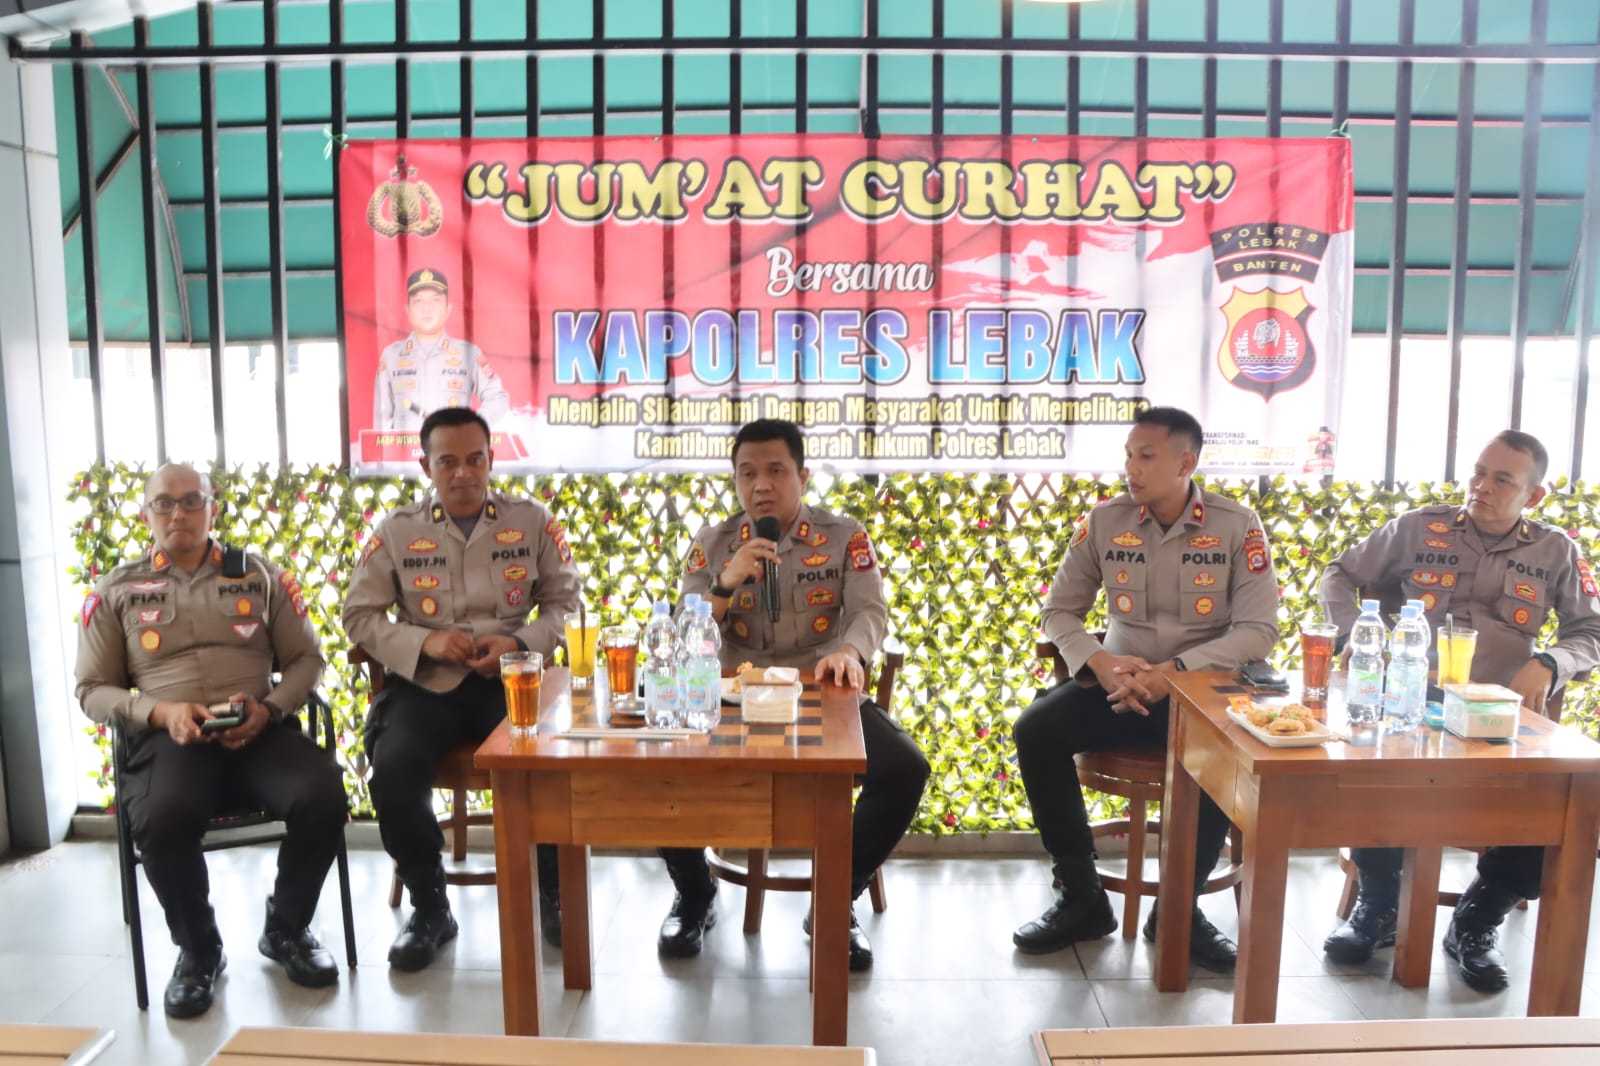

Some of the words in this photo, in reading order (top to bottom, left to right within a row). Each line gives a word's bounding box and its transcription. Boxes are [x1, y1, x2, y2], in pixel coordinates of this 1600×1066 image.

[840, 158, 1236, 222] CURHAT”
[1220, 226, 1319, 243] POLRES
[1238, 238, 1298, 249] LEBAK
[766, 246, 934, 296] Bersama
[1232, 260, 1302, 273] BANTEN
[553, 309, 911, 385] KAPOLRES
[927, 309, 1146, 385] LEBAK
[548, 395, 639, 425] Menjalin
[641, 394, 759, 425] Silaturahmi
[763, 395, 841, 426] Dengan
[845, 393, 964, 429] Masyarakat
[968, 394, 1027, 425] Untuk
[635, 429, 735, 459] Kamtibma
[857, 427, 930, 459] Hukum
[931, 427, 998, 459] Polres
[1000, 427, 1066, 459] Lebak
[491, 547, 531, 561] POLRI
[1105, 550, 1146, 563] ARYA
[1182, 553, 1226, 565] POLRI
[797, 568, 839, 583] POLRI
[1507, 559, 1551, 581] POLRI
[218, 582, 262, 597] POLRI
